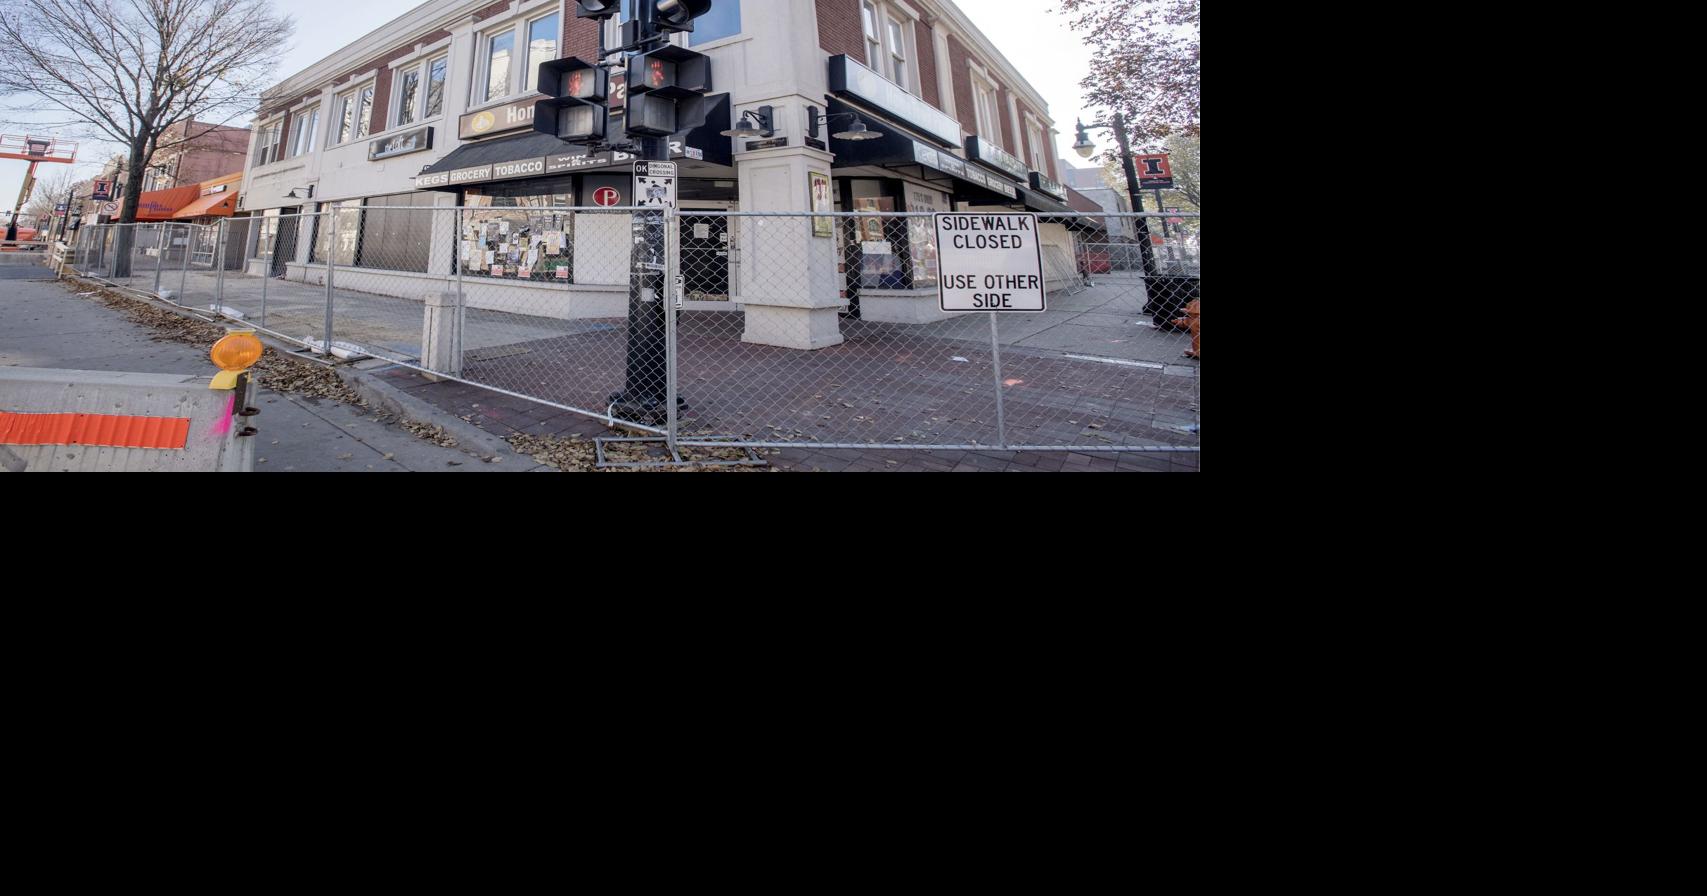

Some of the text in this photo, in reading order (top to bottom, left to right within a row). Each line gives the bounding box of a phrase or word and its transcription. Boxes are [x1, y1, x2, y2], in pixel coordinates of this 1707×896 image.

[610, 82, 624, 99] Pa
[495, 161, 543, 176] TOBACCO
[548, 158, 607, 170] SPIRITS
[636, 164, 648, 173] OK
[1142, 158, 1165, 175] I
[415, 175, 448, 187] KEGS
[450, 168, 491, 182] GROCERY
[942, 216, 1030, 231] SIDEWALK
[953, 234, 1022, 249] CLOSED
[943, 274, 1039, 289] USE OTHER
[972, 293, 1012, 308] SIDE
